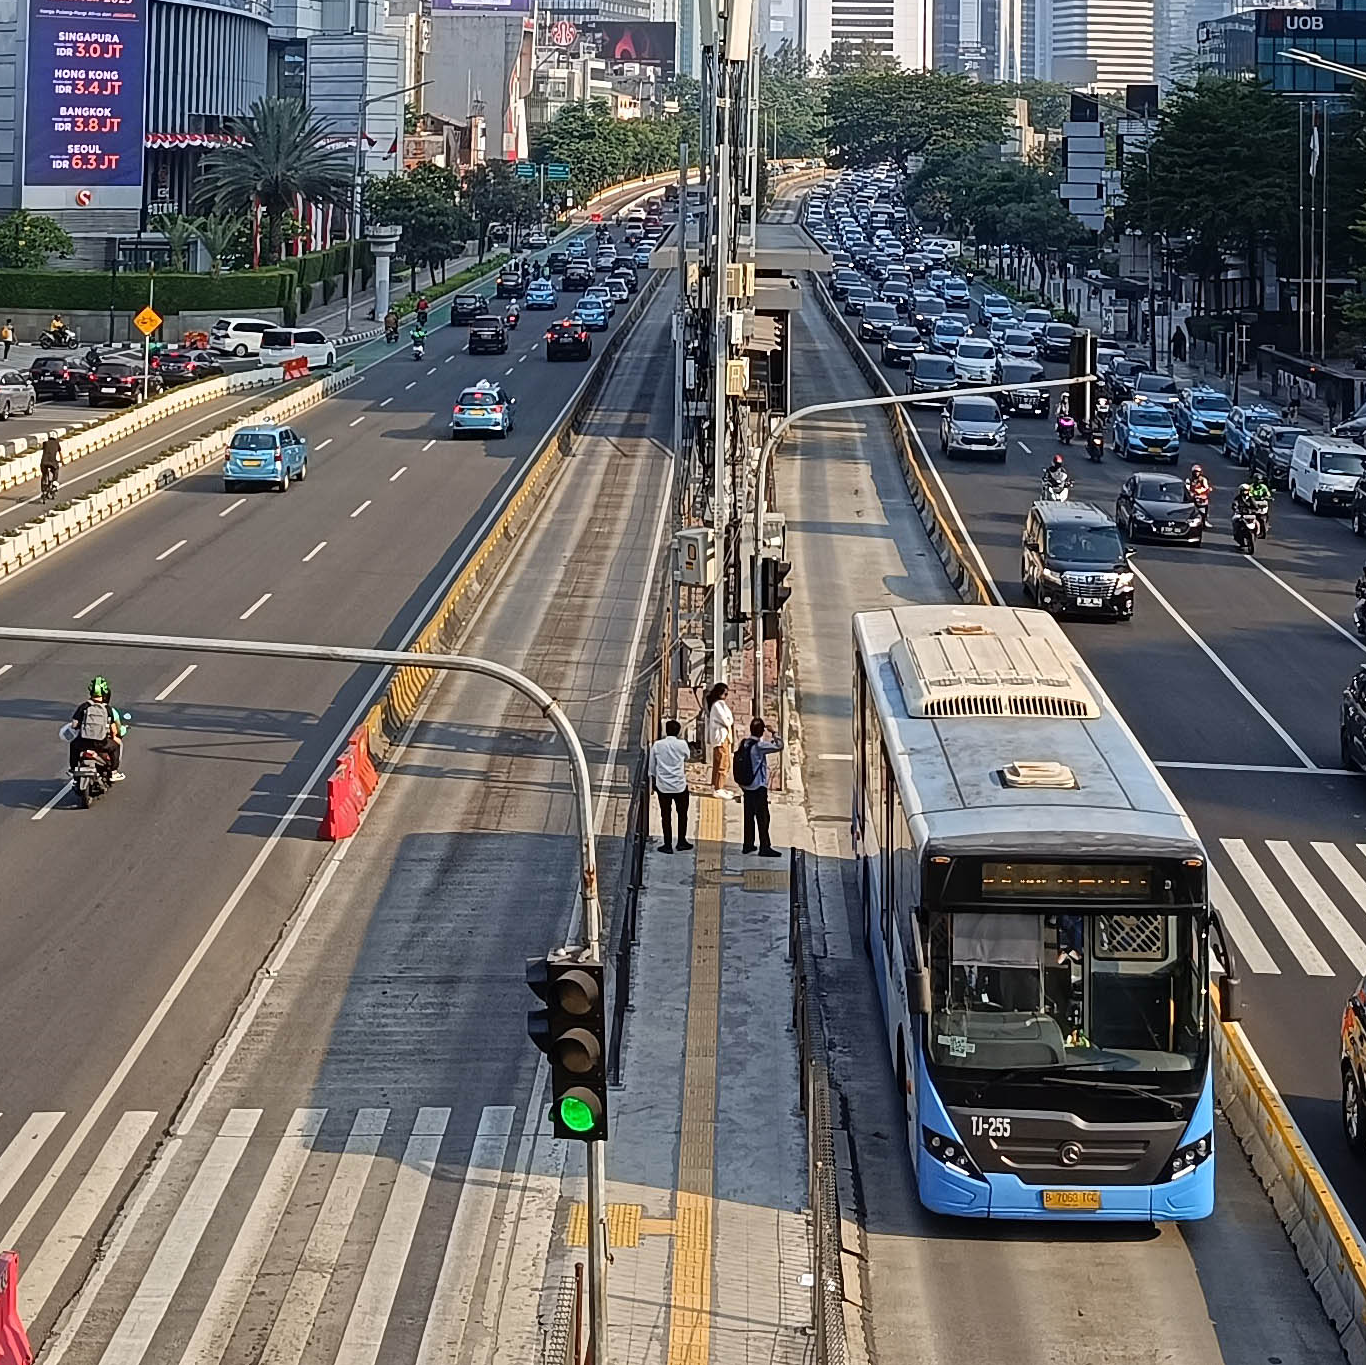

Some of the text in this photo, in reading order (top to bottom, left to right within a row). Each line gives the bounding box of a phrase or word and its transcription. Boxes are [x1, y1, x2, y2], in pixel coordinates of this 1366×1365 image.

[1286, 15, 1324, 30] UOB
[58, 31, 120, 43] SINGAPURA
[56, 43, 124, 58] IDR 3.0 JT
[54, 69, 119, 80] HONG KONG
[55, 80, 123, 95] IDR 3.4 JT
[59, 107, 112, 117] BANGKOK
[54, 117, 122, 132] IDR 3.8 JT
[67, 144, 102, 154] SEOUL
[52, 154, 120, 169] IDR 6.3 JT
[971, 1116, 1011, 1137] TJ-255
